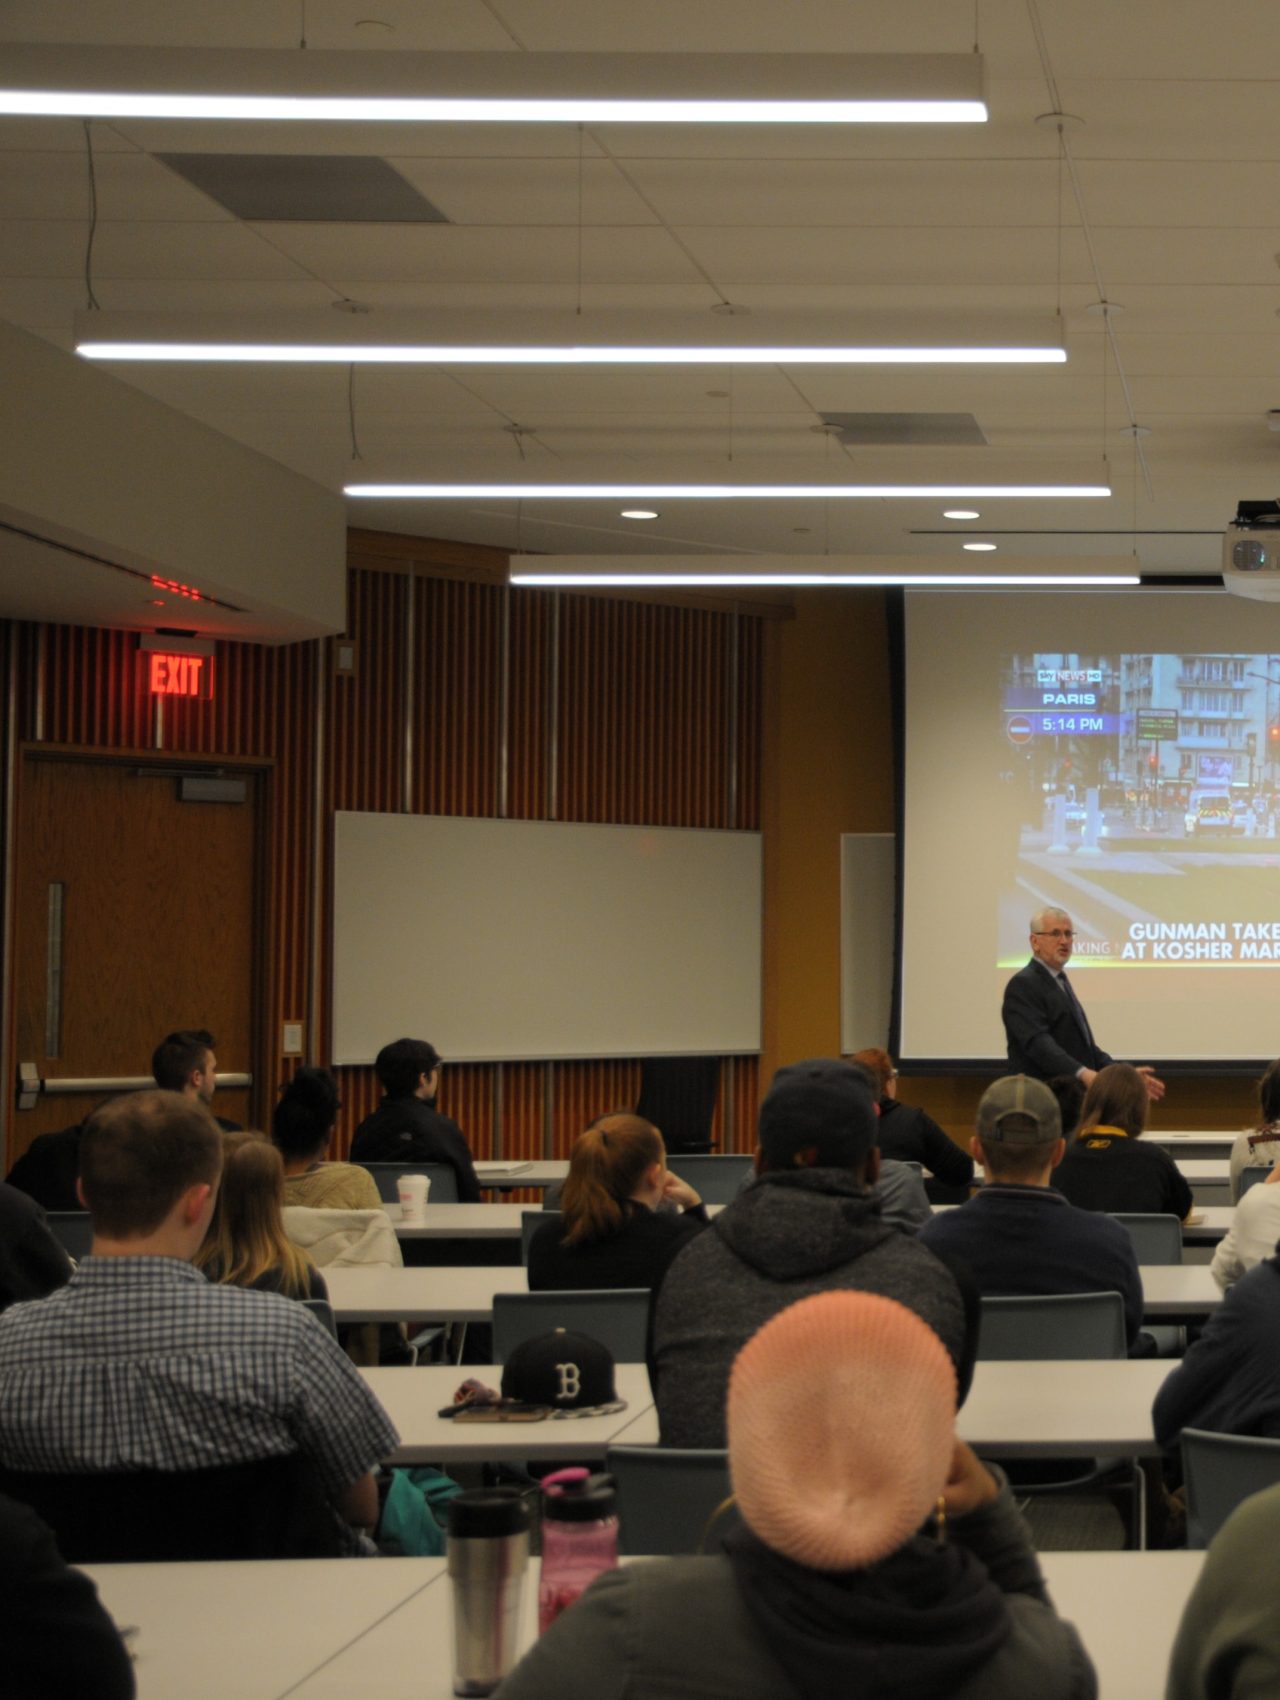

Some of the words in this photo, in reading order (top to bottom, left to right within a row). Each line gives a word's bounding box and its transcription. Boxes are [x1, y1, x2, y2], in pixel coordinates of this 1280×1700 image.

[151, 654, 203, 696] EXIT
[1057, 670, 1086, 681] NEWS
[1043, 693, 1096, 704] PARIS
[1043, 718, 1075, 730] 5:14
[1080, 718, 1103, 730] PM
[1129, 922, 1226, 940] GUNMAN
[1122, 942, 1147, 959] AT
[1153, 941, 1233, 960] KOSHER
[555, 1362, 581, 1399] B
